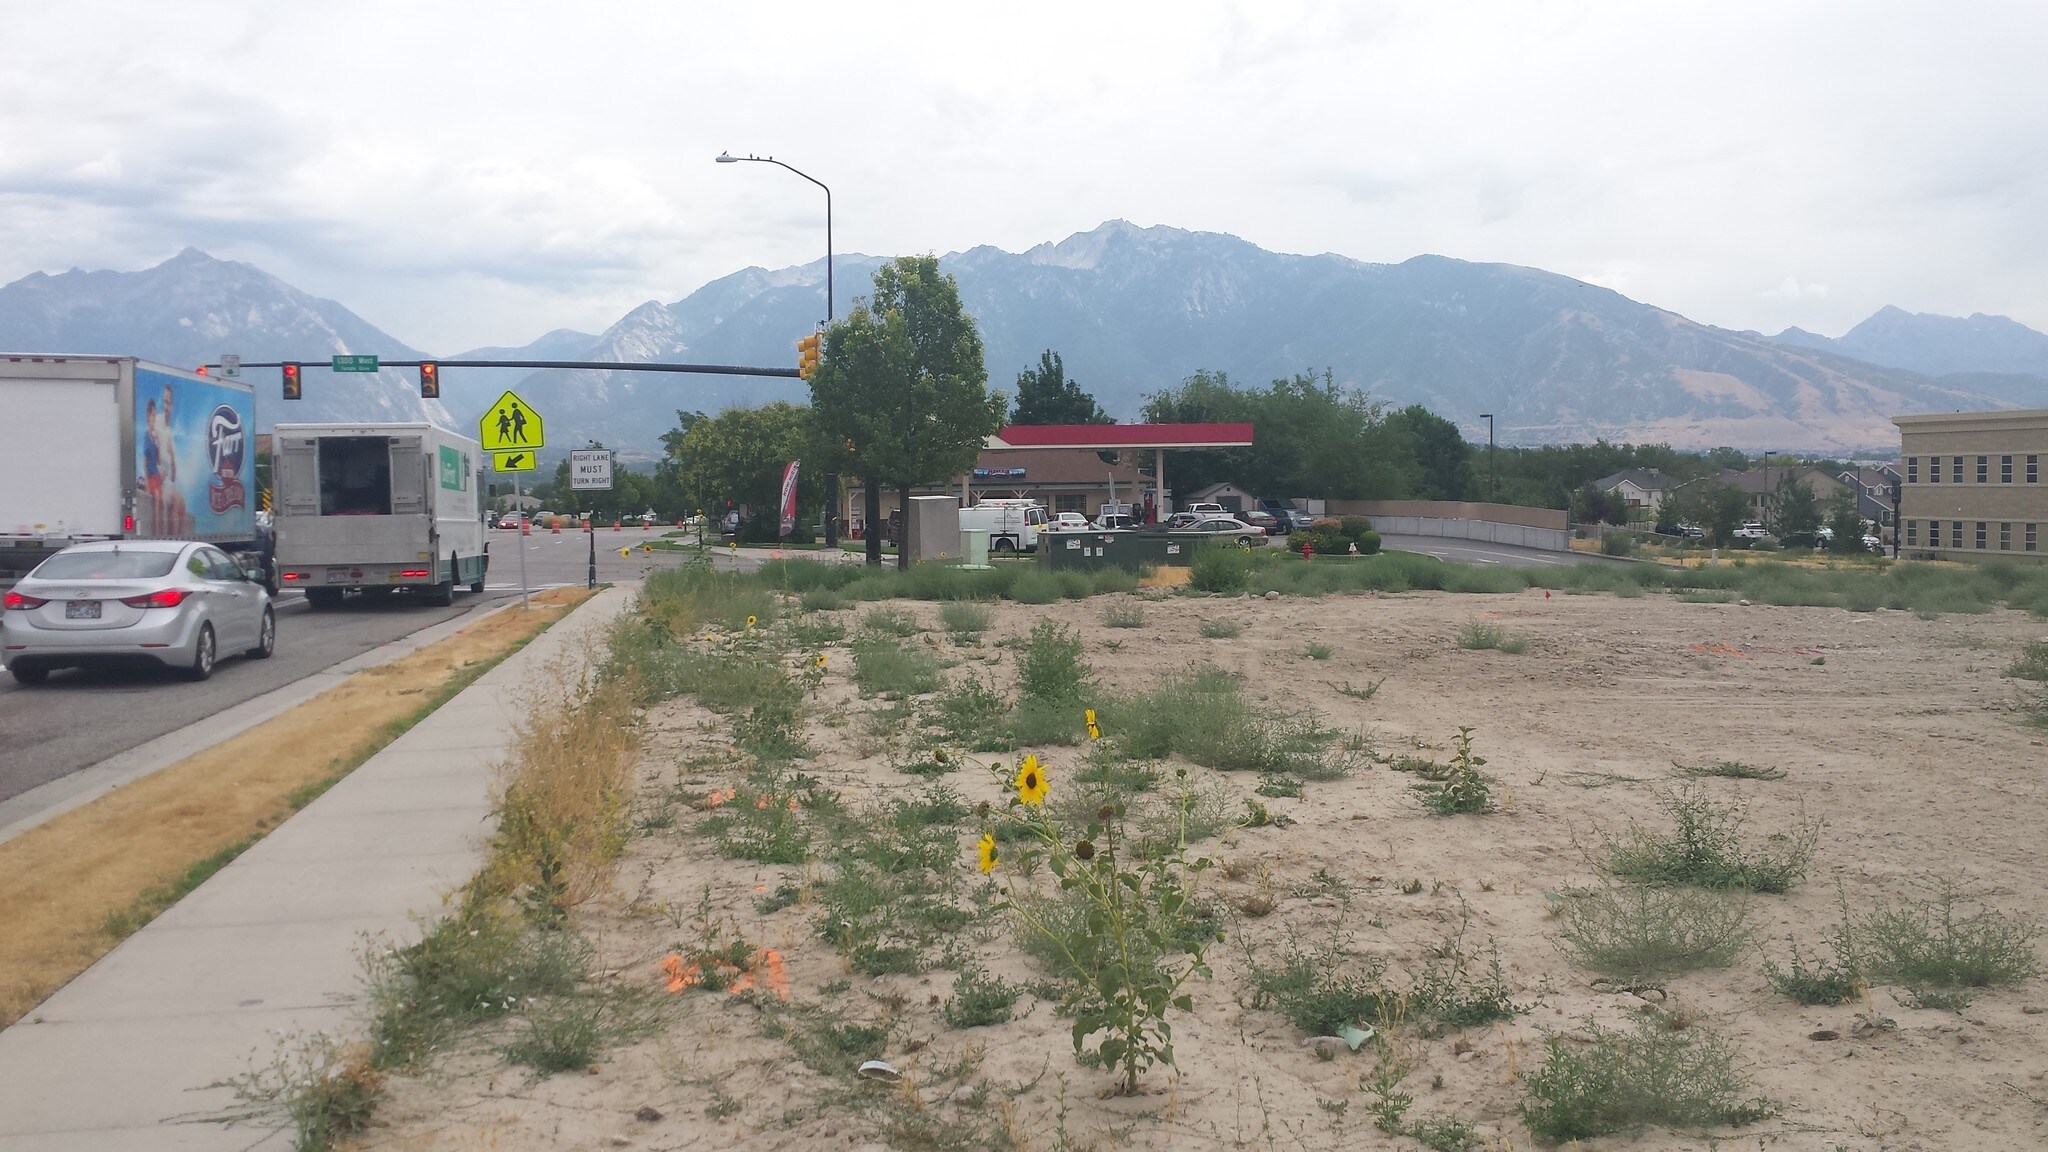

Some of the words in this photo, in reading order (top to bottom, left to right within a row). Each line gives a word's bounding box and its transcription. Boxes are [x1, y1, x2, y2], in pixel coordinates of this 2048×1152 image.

[211, 414, 242, 474] Farr
[572, 454, 591, 462] RIGHT
[580, 465, 603, 474] MUST
[573, 477, 590, 485] TURN
